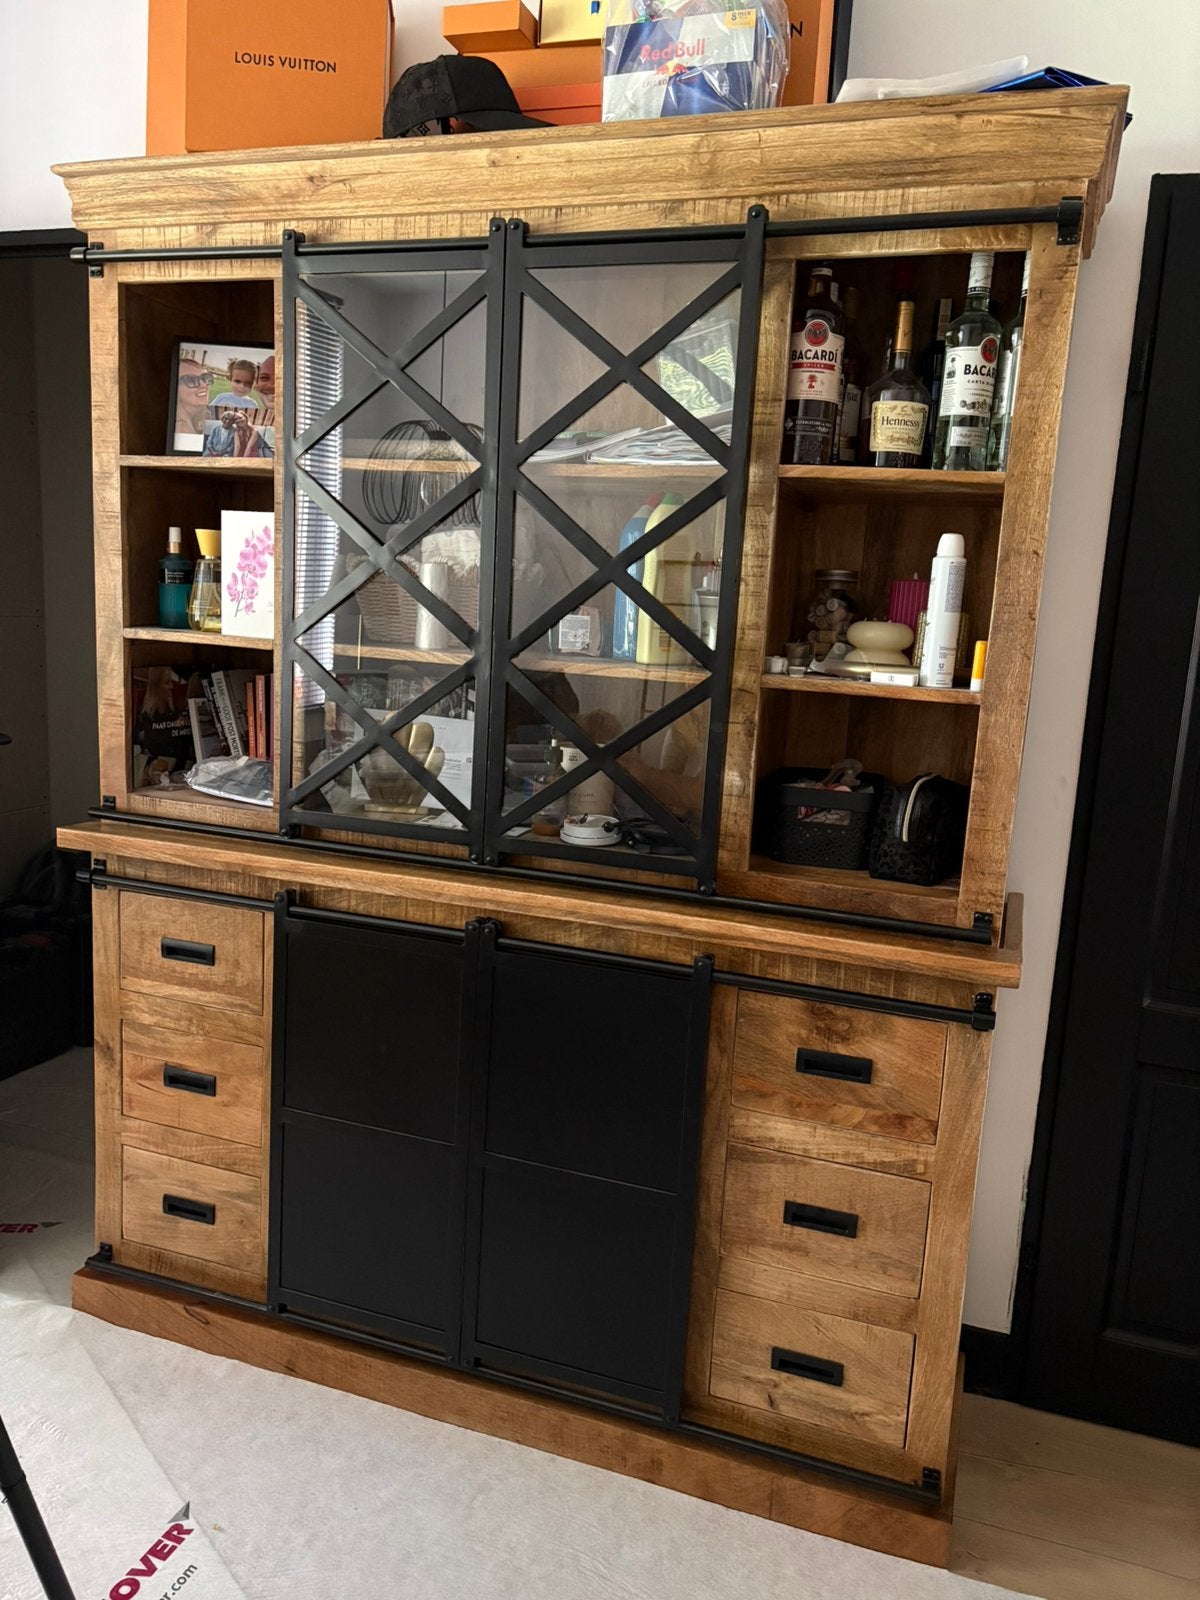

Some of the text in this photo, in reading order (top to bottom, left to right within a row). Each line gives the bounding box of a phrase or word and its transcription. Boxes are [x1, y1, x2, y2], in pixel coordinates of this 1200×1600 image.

[640, 38, 705, 61] Red Bull
[234, 51, 337, 73] LOUIS VUITTON
[881, 415, 920, 429] Hennessy
[226, 721, 236, 738] POST
[101, 1522, 195, 1600] OVER
